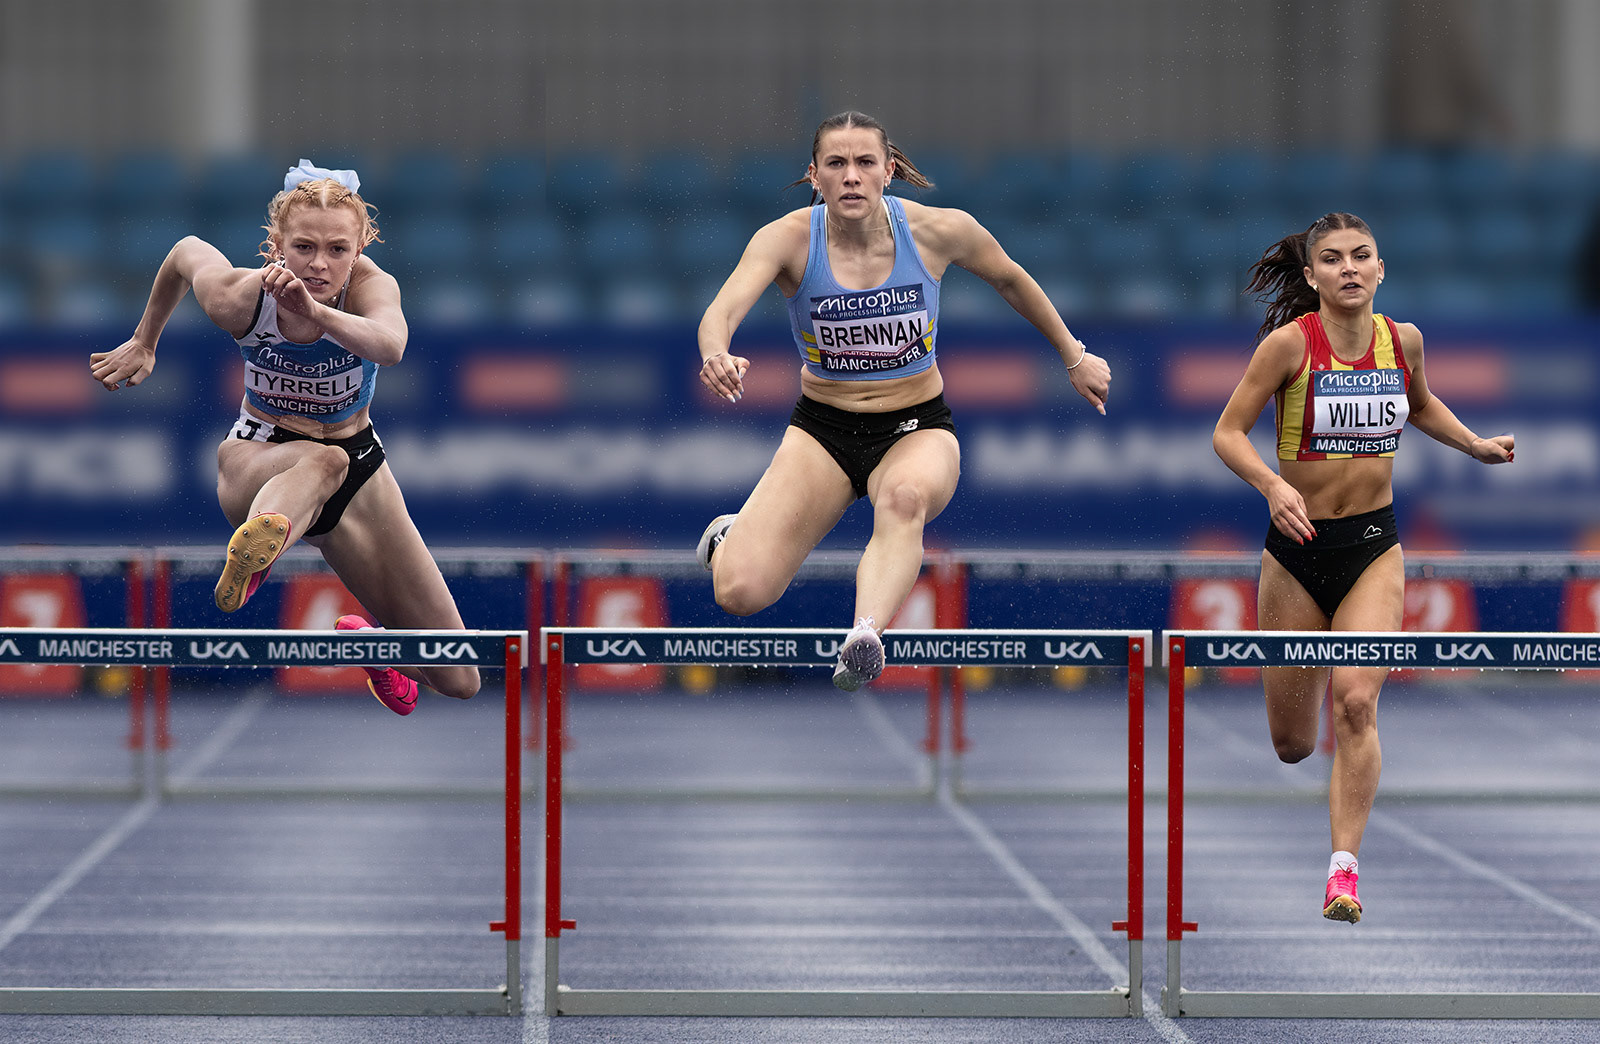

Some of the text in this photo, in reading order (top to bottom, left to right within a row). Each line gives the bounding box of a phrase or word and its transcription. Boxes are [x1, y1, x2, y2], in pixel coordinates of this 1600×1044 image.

[839, 308, 882, 318] PROCESSING
[892, 303, 917, 312] TIMING
[819, 318, 922, 348] BRENNAN
[255, 358, 272, 369] DATA
[826, 345, 922, 371] MANCHESTER
[249, 368, 357, 396] TYRRELL
[1328, 401, 1396, 428] WILLIS
[1315, 437, 1397, 452] MANCHESTER
[39, 640, 173, 658] MANCHESTER
[190, 641, 250, 659] UKA
[267, 642, 402, 660] MANCHESTER
[419, 642, 479, 660] UKA
[586, 640, 647, 657] UKA
[664, 640, 798, 657] MANCHESTER
[893, 641, 1026, 659] MANCHESTER
[1044, 641, 1104, 659] UKA
[1207, 642, 1600, 661] UKA MANCHESTER UKA MANCHE
